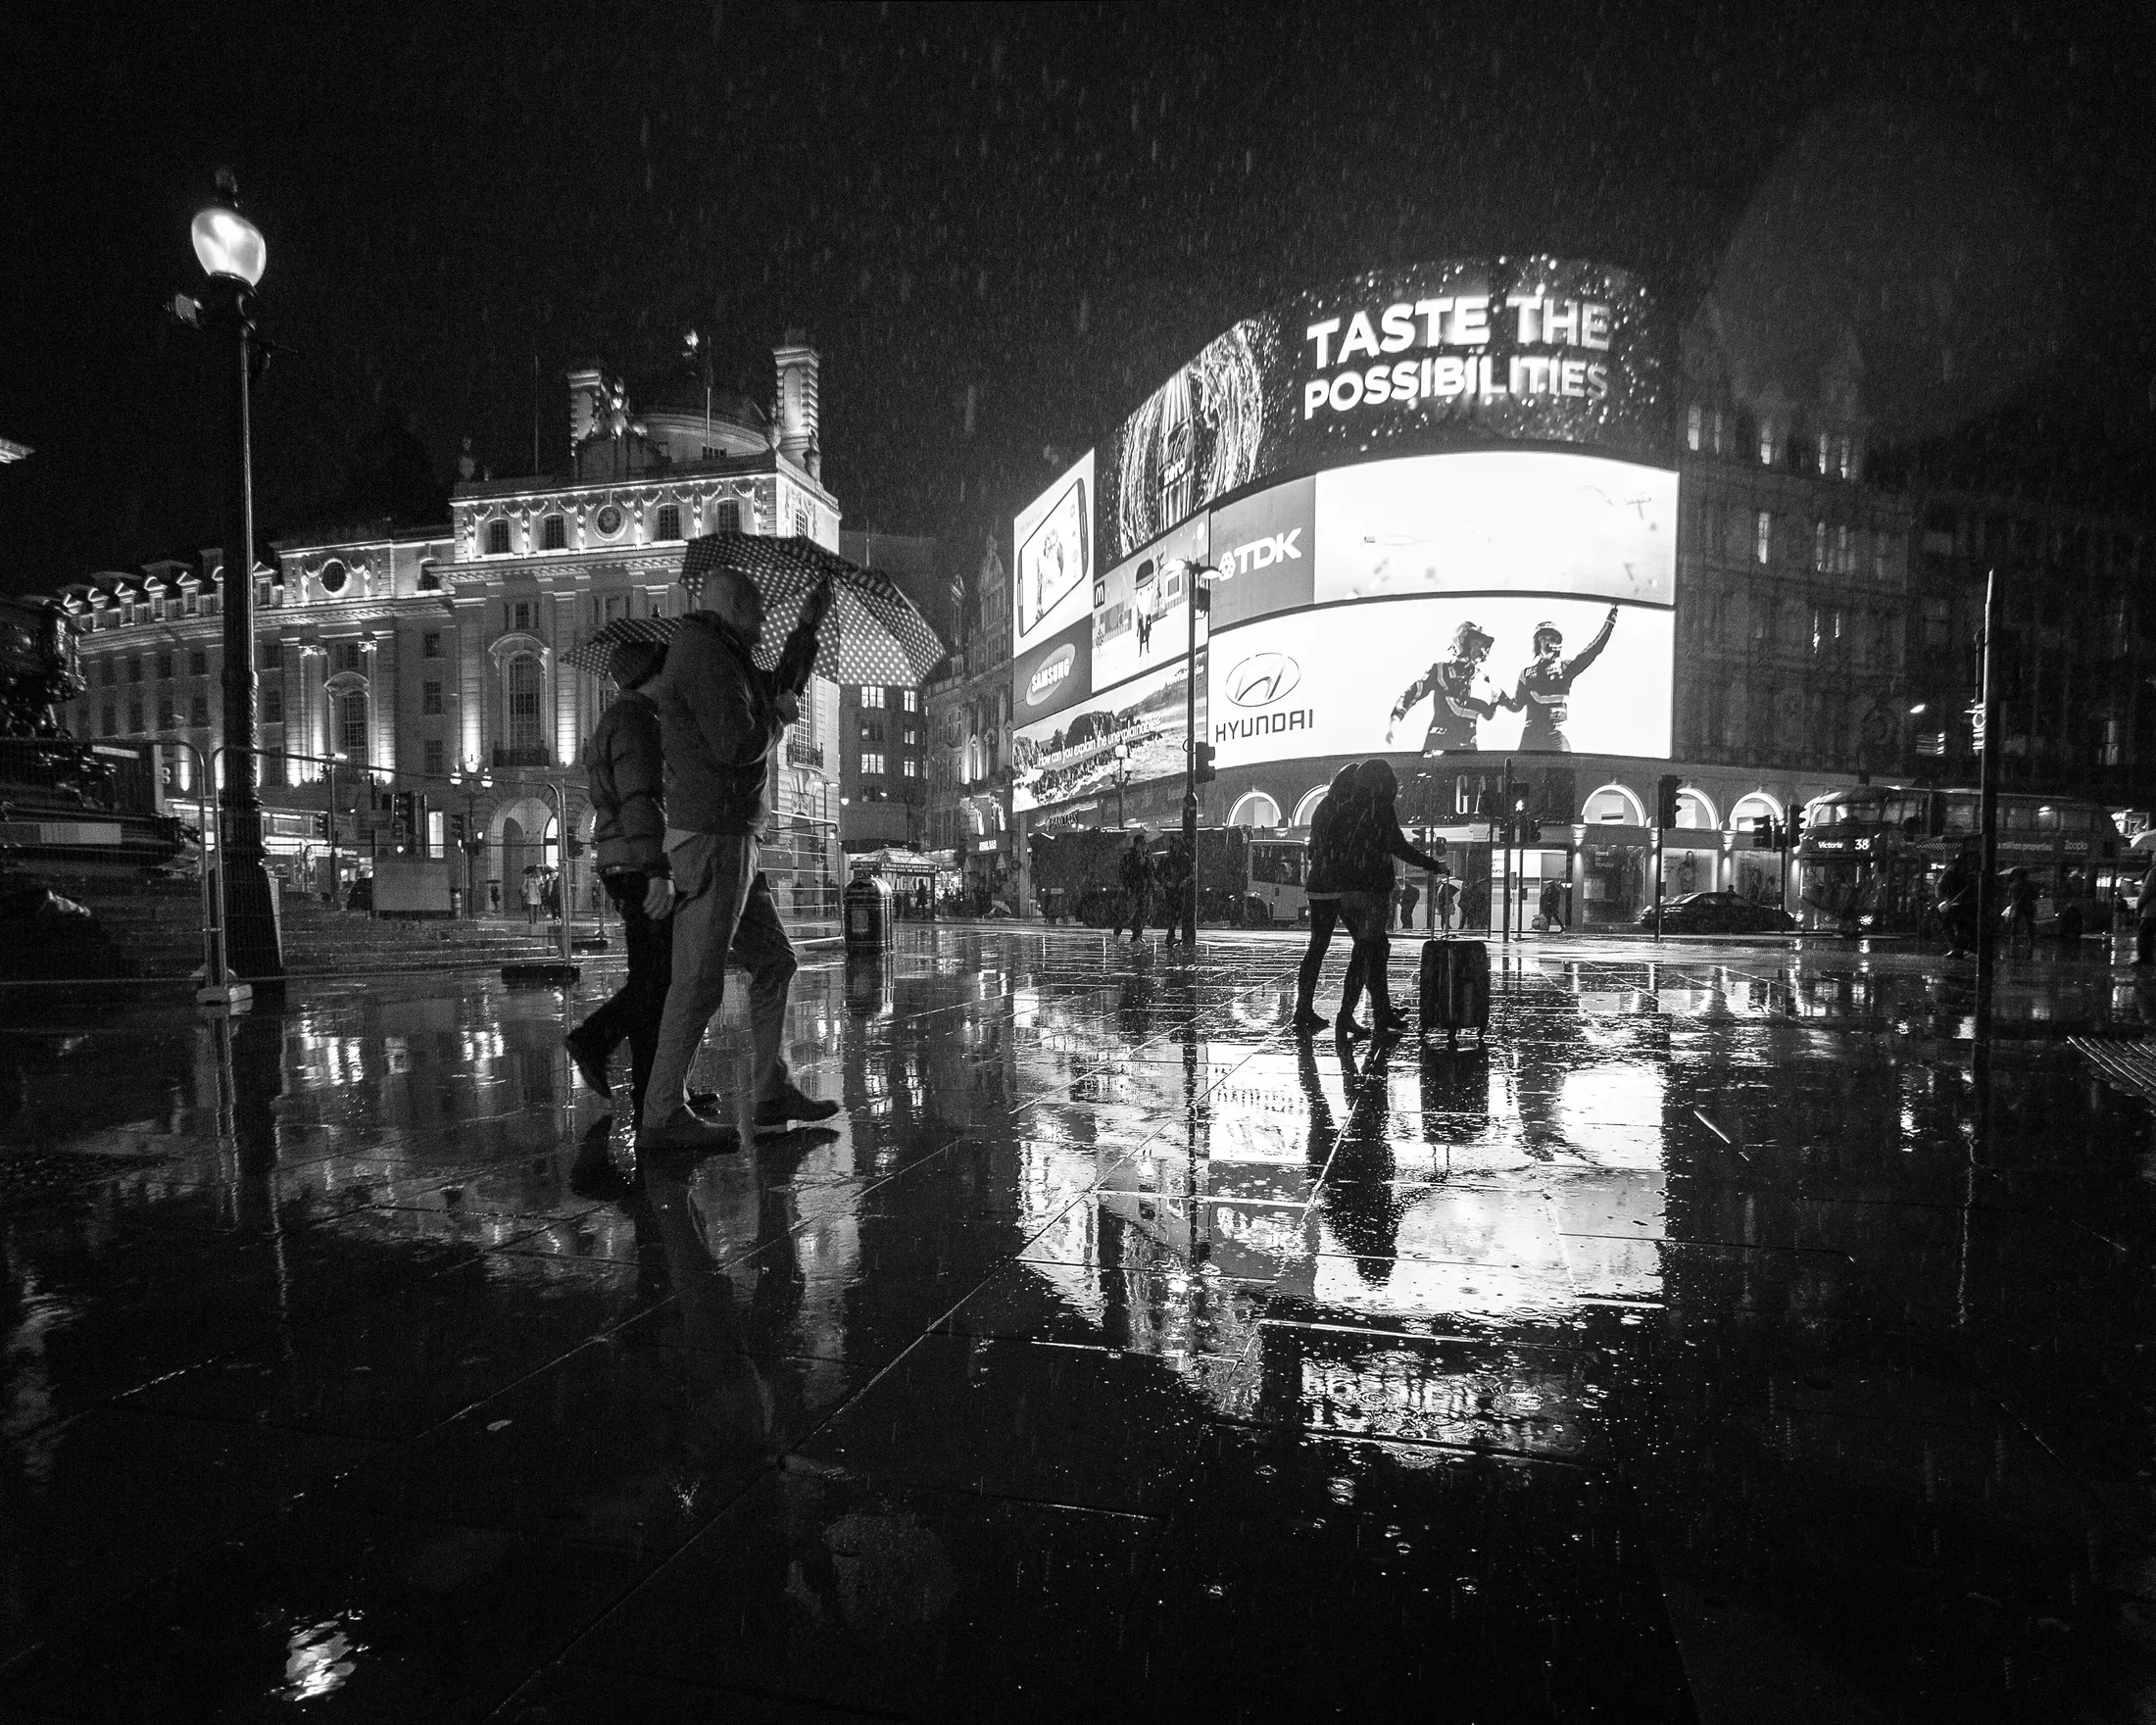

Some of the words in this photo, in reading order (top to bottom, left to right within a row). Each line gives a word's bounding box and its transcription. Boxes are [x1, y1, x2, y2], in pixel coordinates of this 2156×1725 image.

[1306, 296, 1491, 370] TASTE
[1505, 294, 1610, 351] THE
[1304, 354, 1609, 420] POSSIBILITIES
[1163, 457, 1186, 487] zero
[1233, 527, 1302, 575] TDK
[1031, 658, 1071, 693] SAMSUNG
[1215, 709, 1314, 744] HYUNDAI
[1039, 752, 1052, 767] How
[1051, 750, 1062, 763] can
[1061, 743, 1074, 764] you
[1074, 735, 1097, 759] explain
[1097, 730, 1107, 749] the
[1818, 840, 1843, 849] Victoria
[1854, 838, 1871, 851] 38
